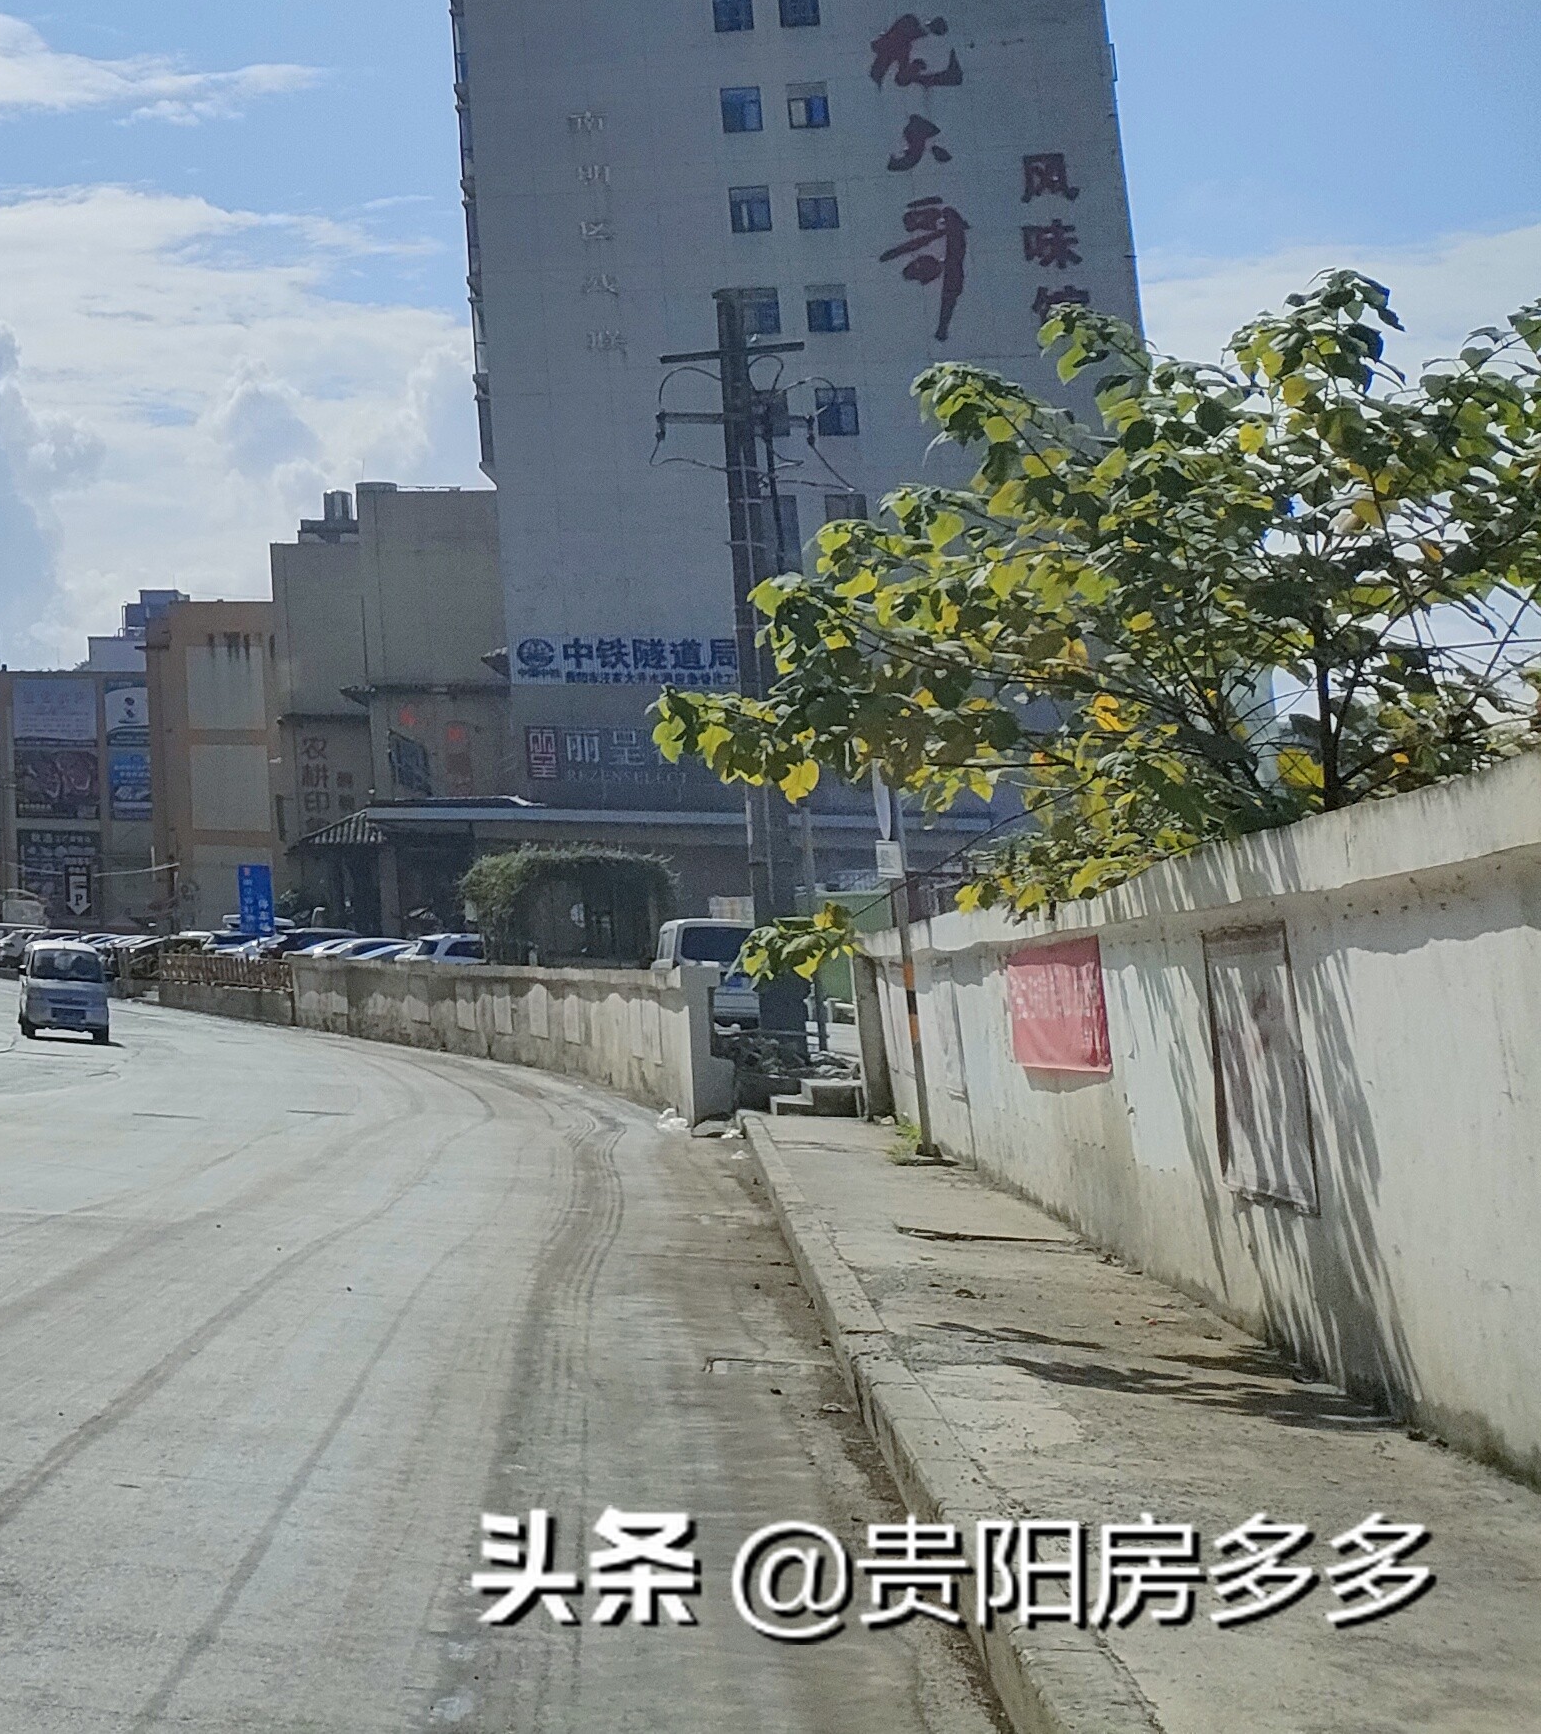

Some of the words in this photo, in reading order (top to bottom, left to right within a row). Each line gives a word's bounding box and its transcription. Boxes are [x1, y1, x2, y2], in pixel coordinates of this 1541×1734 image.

[562, 637, 738, 671] 中铁隧道局
[74, 894, 84, 906] P
